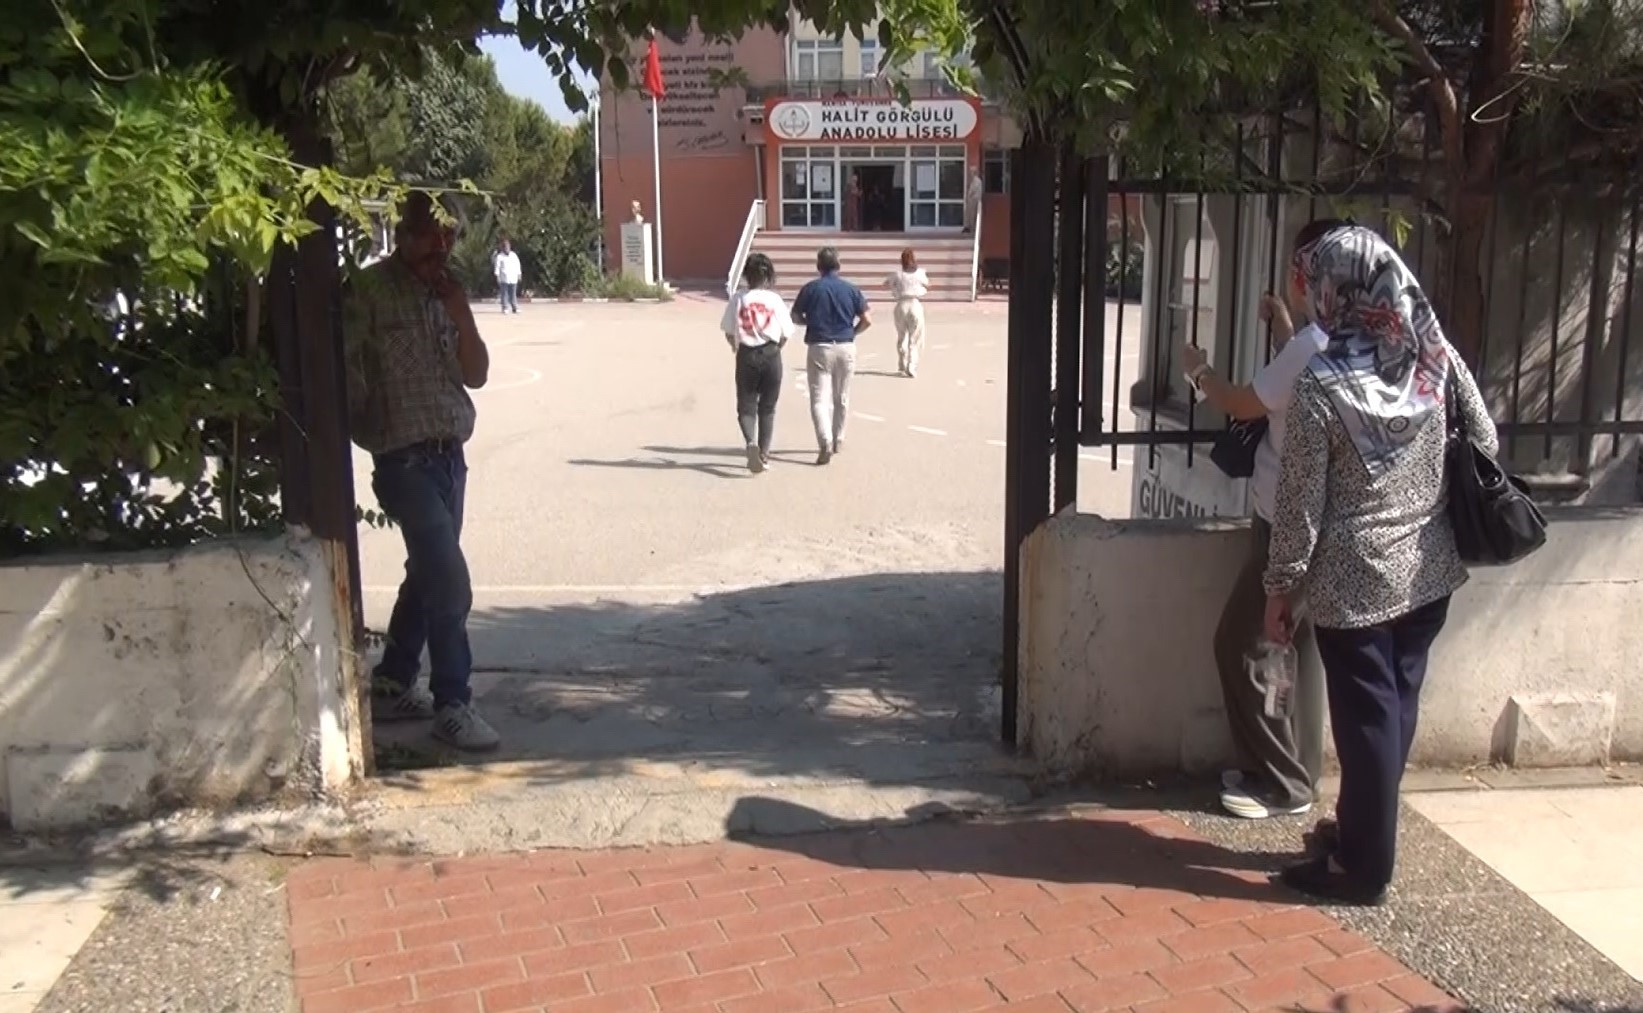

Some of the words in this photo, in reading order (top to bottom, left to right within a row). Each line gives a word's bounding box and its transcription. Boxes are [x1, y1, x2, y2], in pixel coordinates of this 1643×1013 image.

[822, 107, 869, 122] HALİT
[876, 107, 953, 123] GÖRGÜLÜ
[820, 126, 897, 139] ANADOLU
[906, 123, 957, 139] LİSESİ
